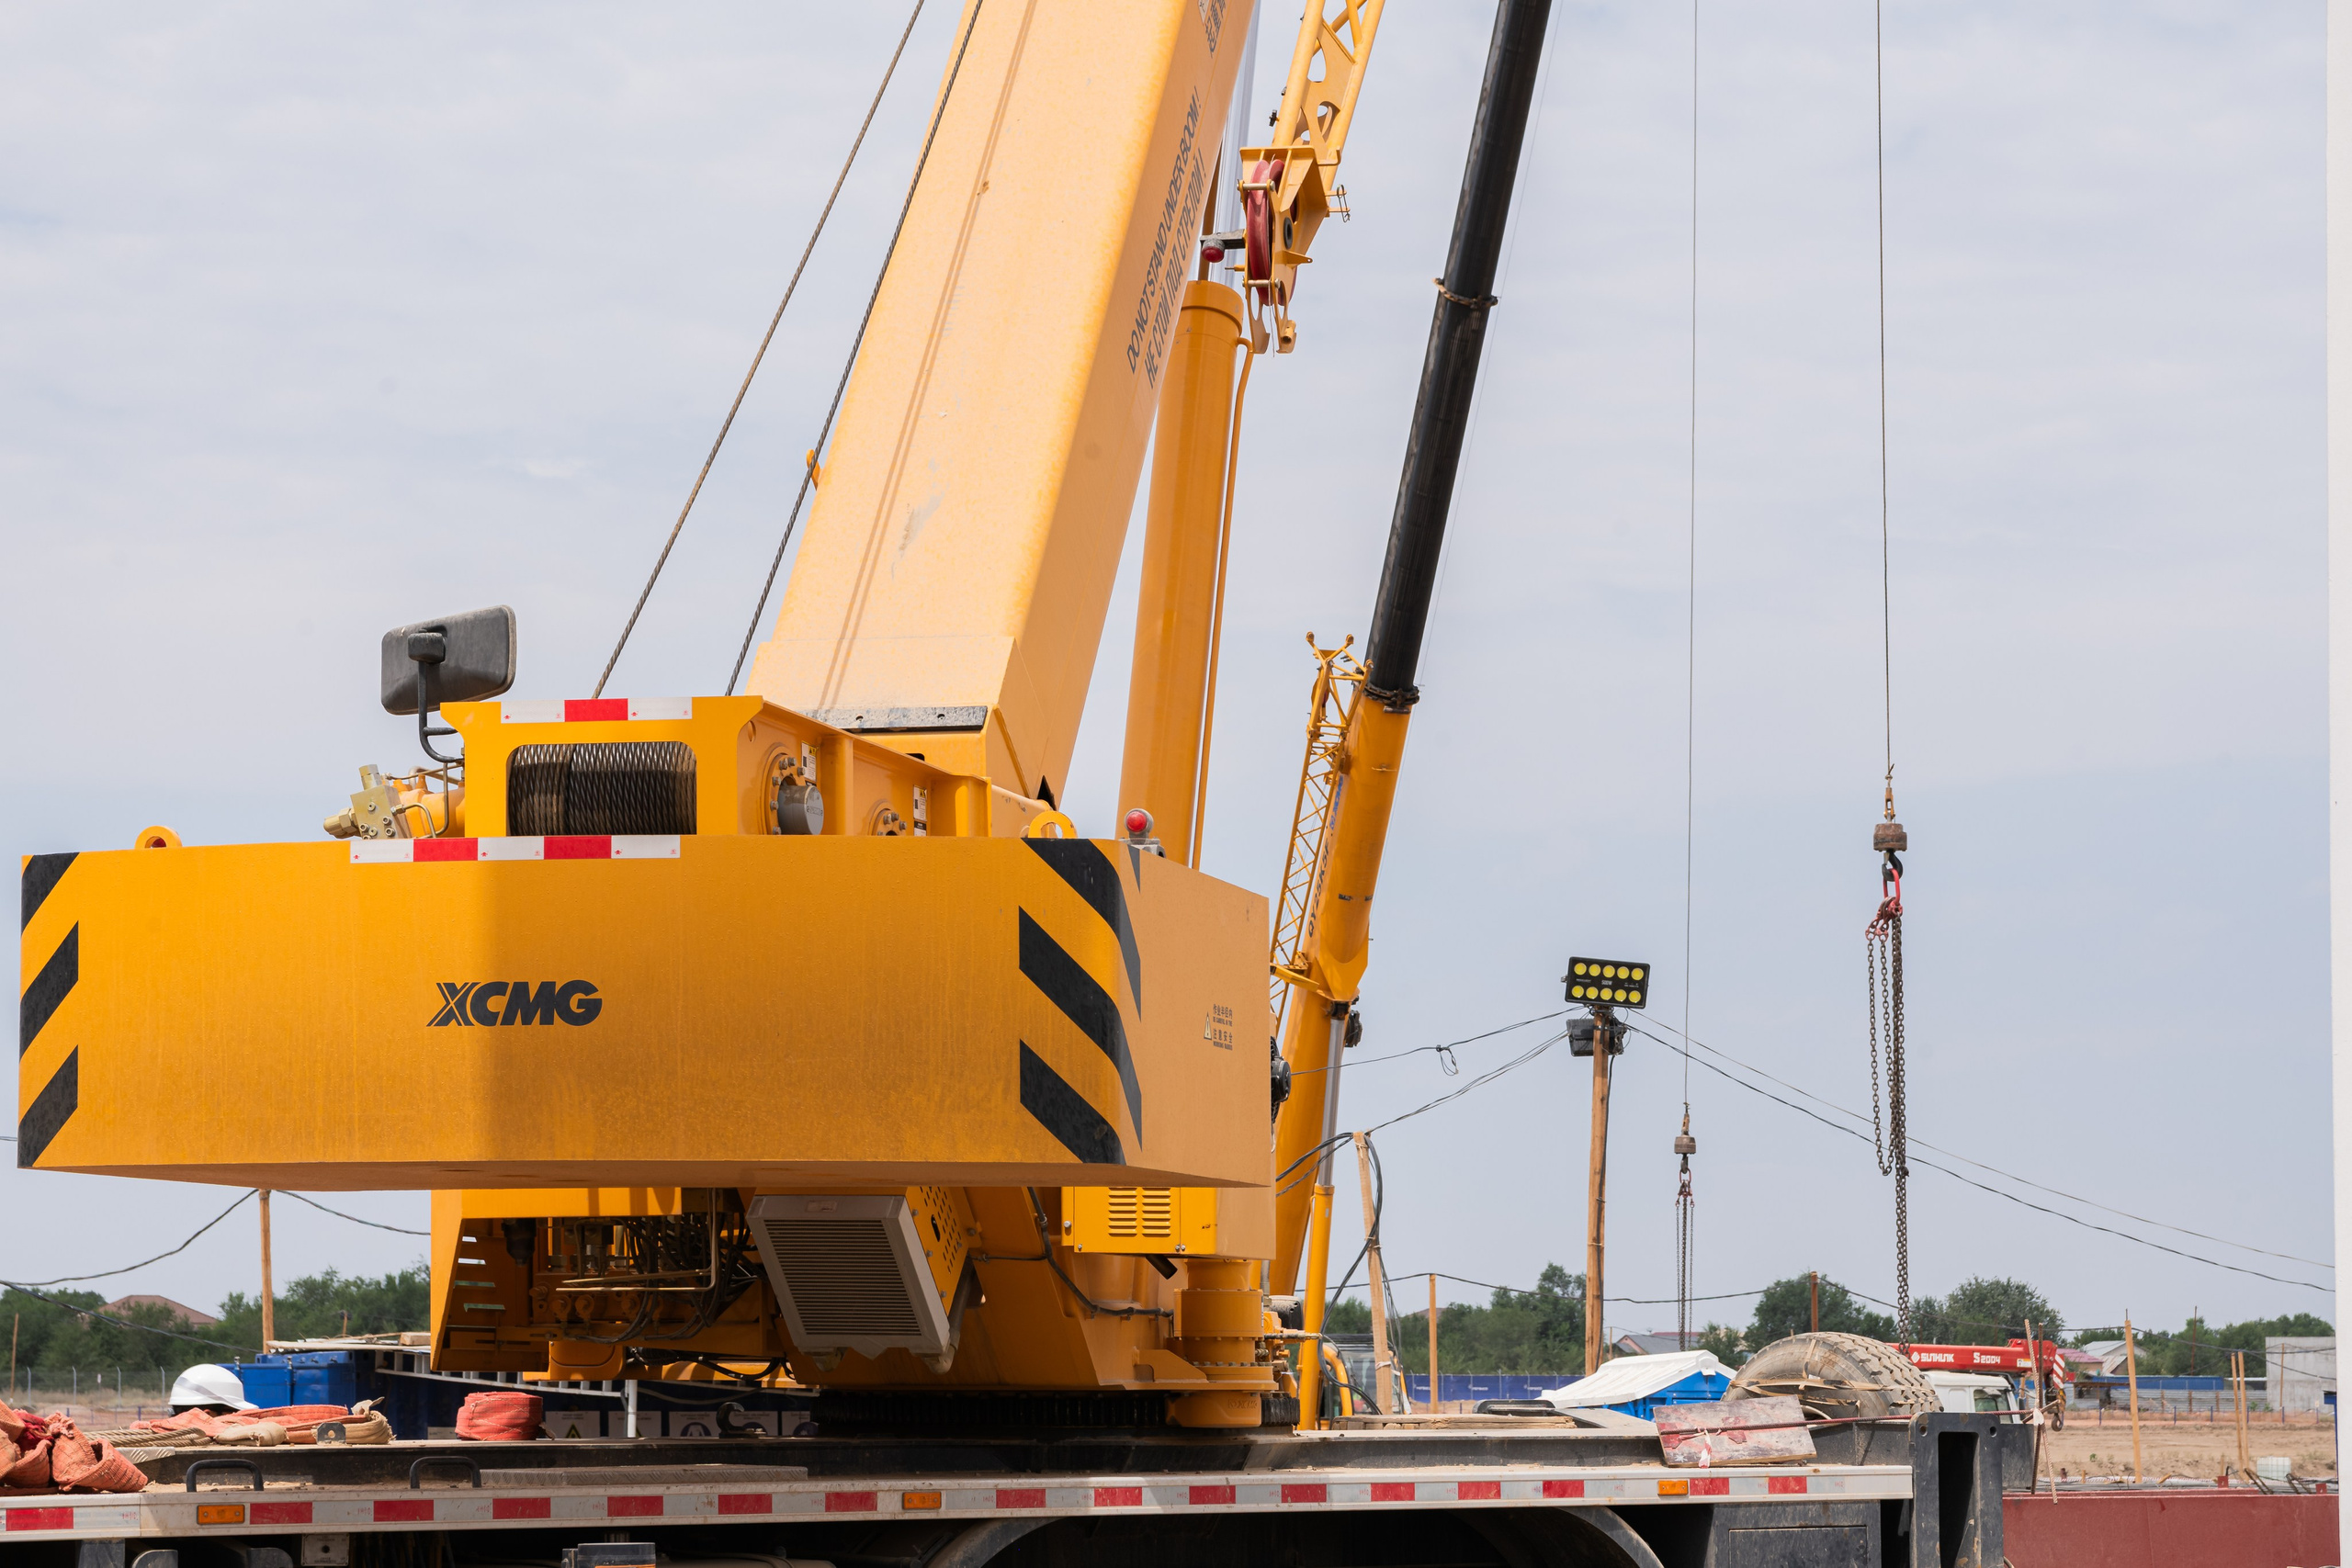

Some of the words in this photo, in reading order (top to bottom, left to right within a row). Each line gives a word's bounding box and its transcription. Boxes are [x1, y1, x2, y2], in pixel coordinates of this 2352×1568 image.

[1126, 329, 1140, 375] DO
[1135, 284, 1152, 342] NOT
[1147, 221, 1168, 298] STAND
[1162, 153, 1185, 232] UNDER
[1144, 341, 1159, 389] НЕ
[1152, 282, 1171, 358] СТОЙ
[1165, 243, 1183, 308] ПОД
[425, 979, 603, 1027] XCMG
